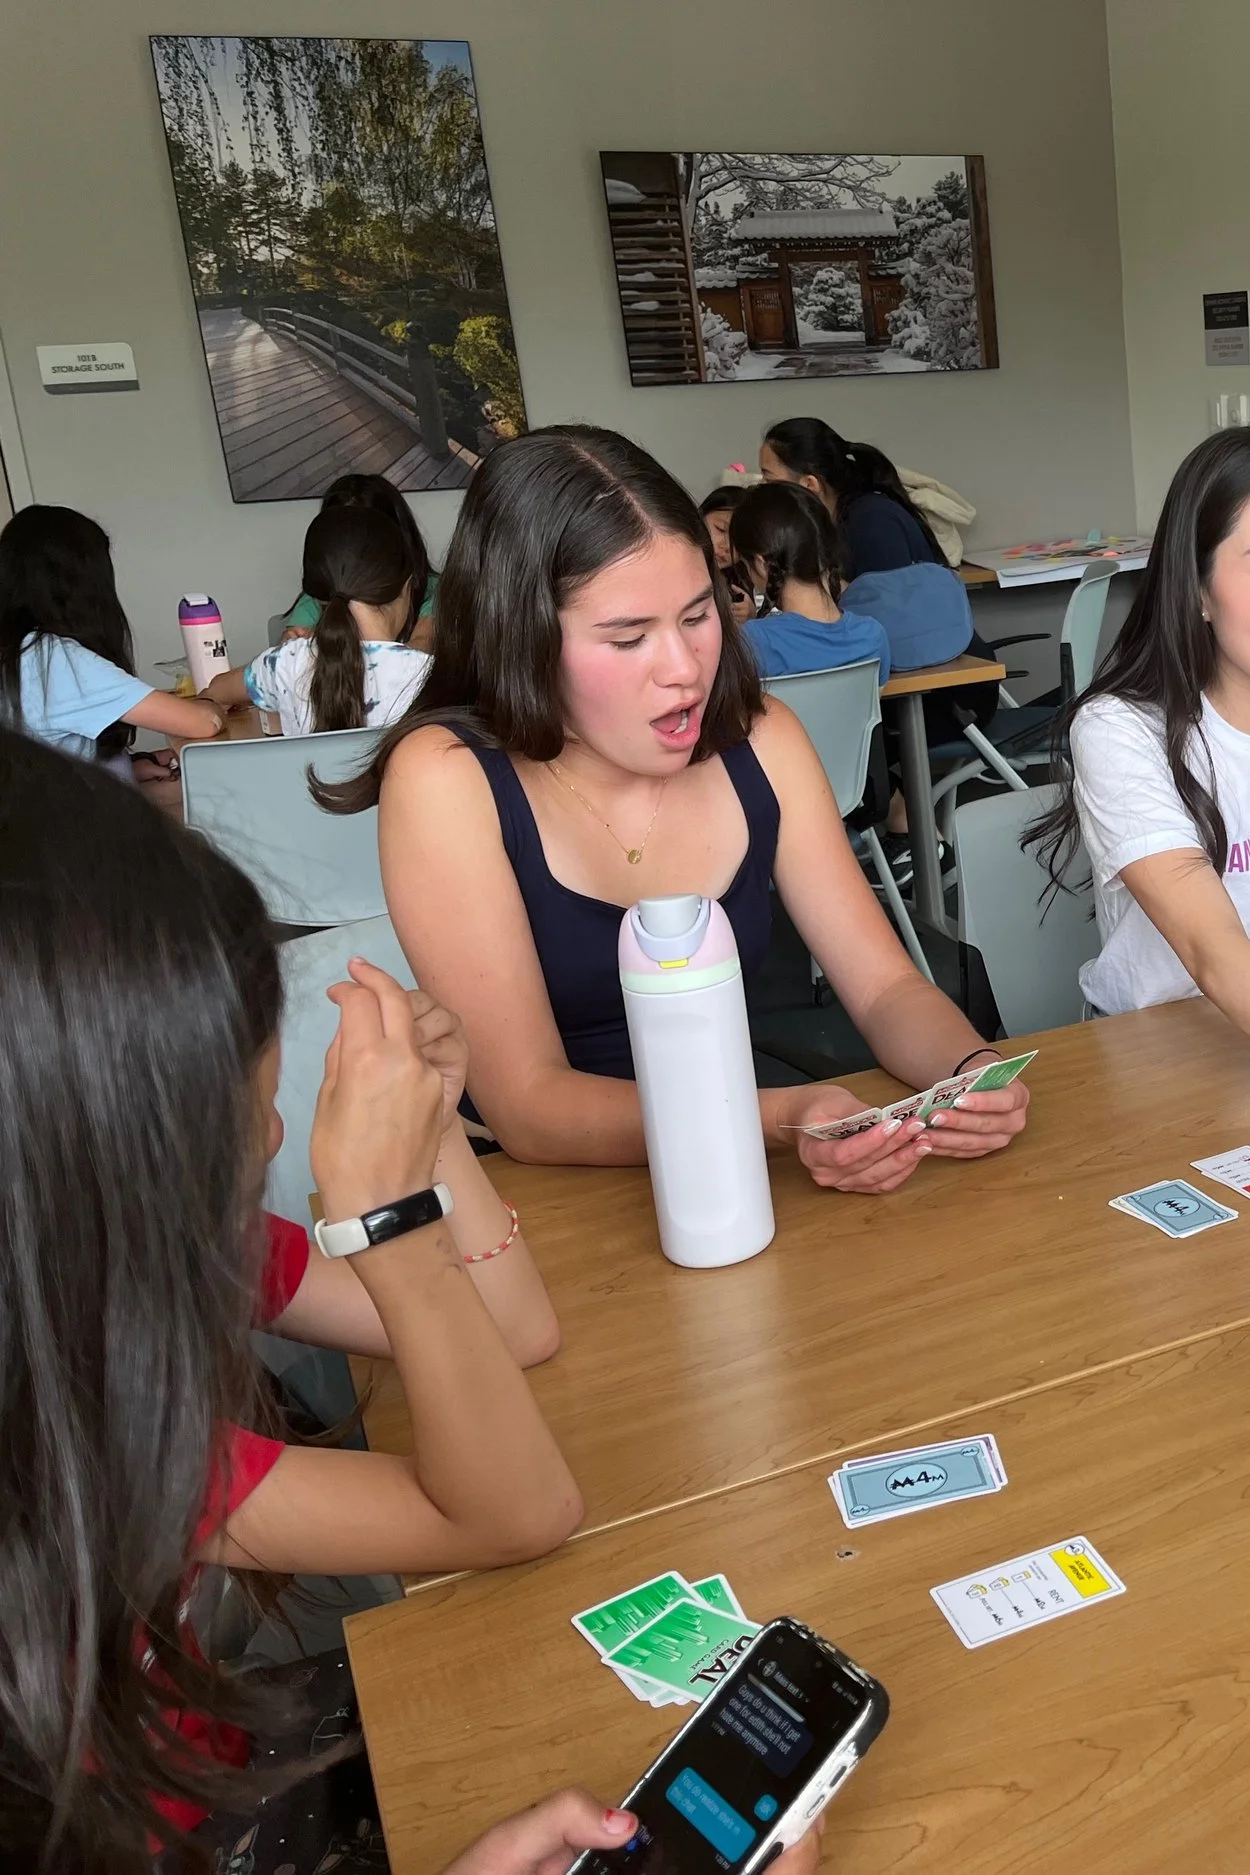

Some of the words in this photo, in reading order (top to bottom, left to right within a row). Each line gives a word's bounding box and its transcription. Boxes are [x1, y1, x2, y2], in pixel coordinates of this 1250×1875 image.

[51, 364, 93, 374] STORAGE
[95, 362, 125, 372] SOUTH
[77, 354, 97, 362] 101B
[1073, 1558, 1093, 1580] ATLANTIC
[1047, 1588, 1064, 1605] RENT
[737, 1684, 755, 1703] Guys
[751, 1698, 762, 1710] do
[759, 1705, 767, 1714] u
[763, 1707, 781, 1726] think
[778, 1719, 788, 1730] if
[786, 1729, 800, 1743] get
[718, 1706, 734, 1725] hate
[731, 1719, 743, 1733] me
[740, 1727, 768, 1756] anymore
[727, 1697, 742, 1712] one
[739, 1705, 751, 1719] for
[747, 1714, 765, 1732] edith
[777, 1740, 790, 1755] not
[681, 1774, 693, 1790] You
[689, 1785, 702, 1798] do
